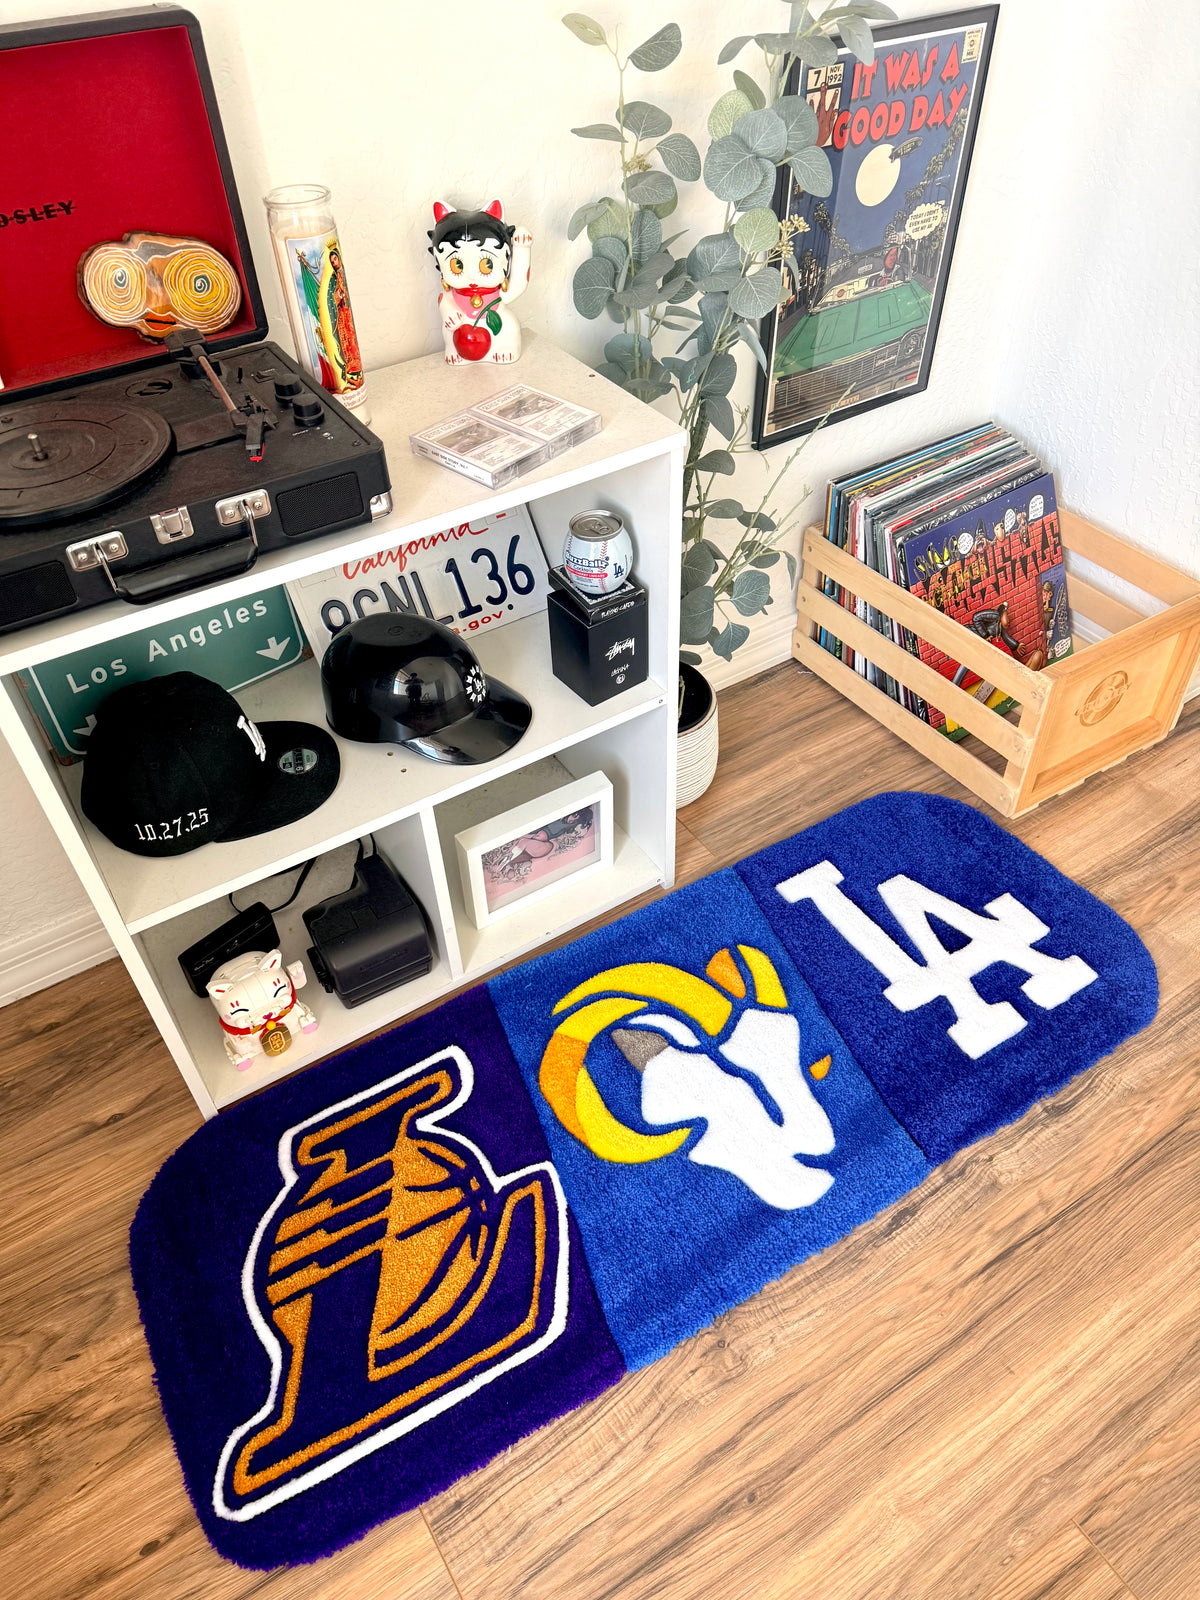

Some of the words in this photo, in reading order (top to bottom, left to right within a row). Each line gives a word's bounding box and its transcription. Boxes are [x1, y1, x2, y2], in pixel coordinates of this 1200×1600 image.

[813, 69, 822, 87] 7
[827, 73, 842, 84] 1992
[829, 65, 842, 75] NOV.
[851, 58, 878, 100] IT
[885, 44, 938, 94] WAS
[941, 42, 960, 82] A
[832, 101, 906, 150] GOOD
[909, 82, 968, 132] DAY
[613, 562, 625, 579] LA
[66, 658, 128, 694] Los
[148, 599, 268, 662] Angeles
[134, 807, 210, 841] 10.27.25
[775, 859, 1099, 1061] LA
